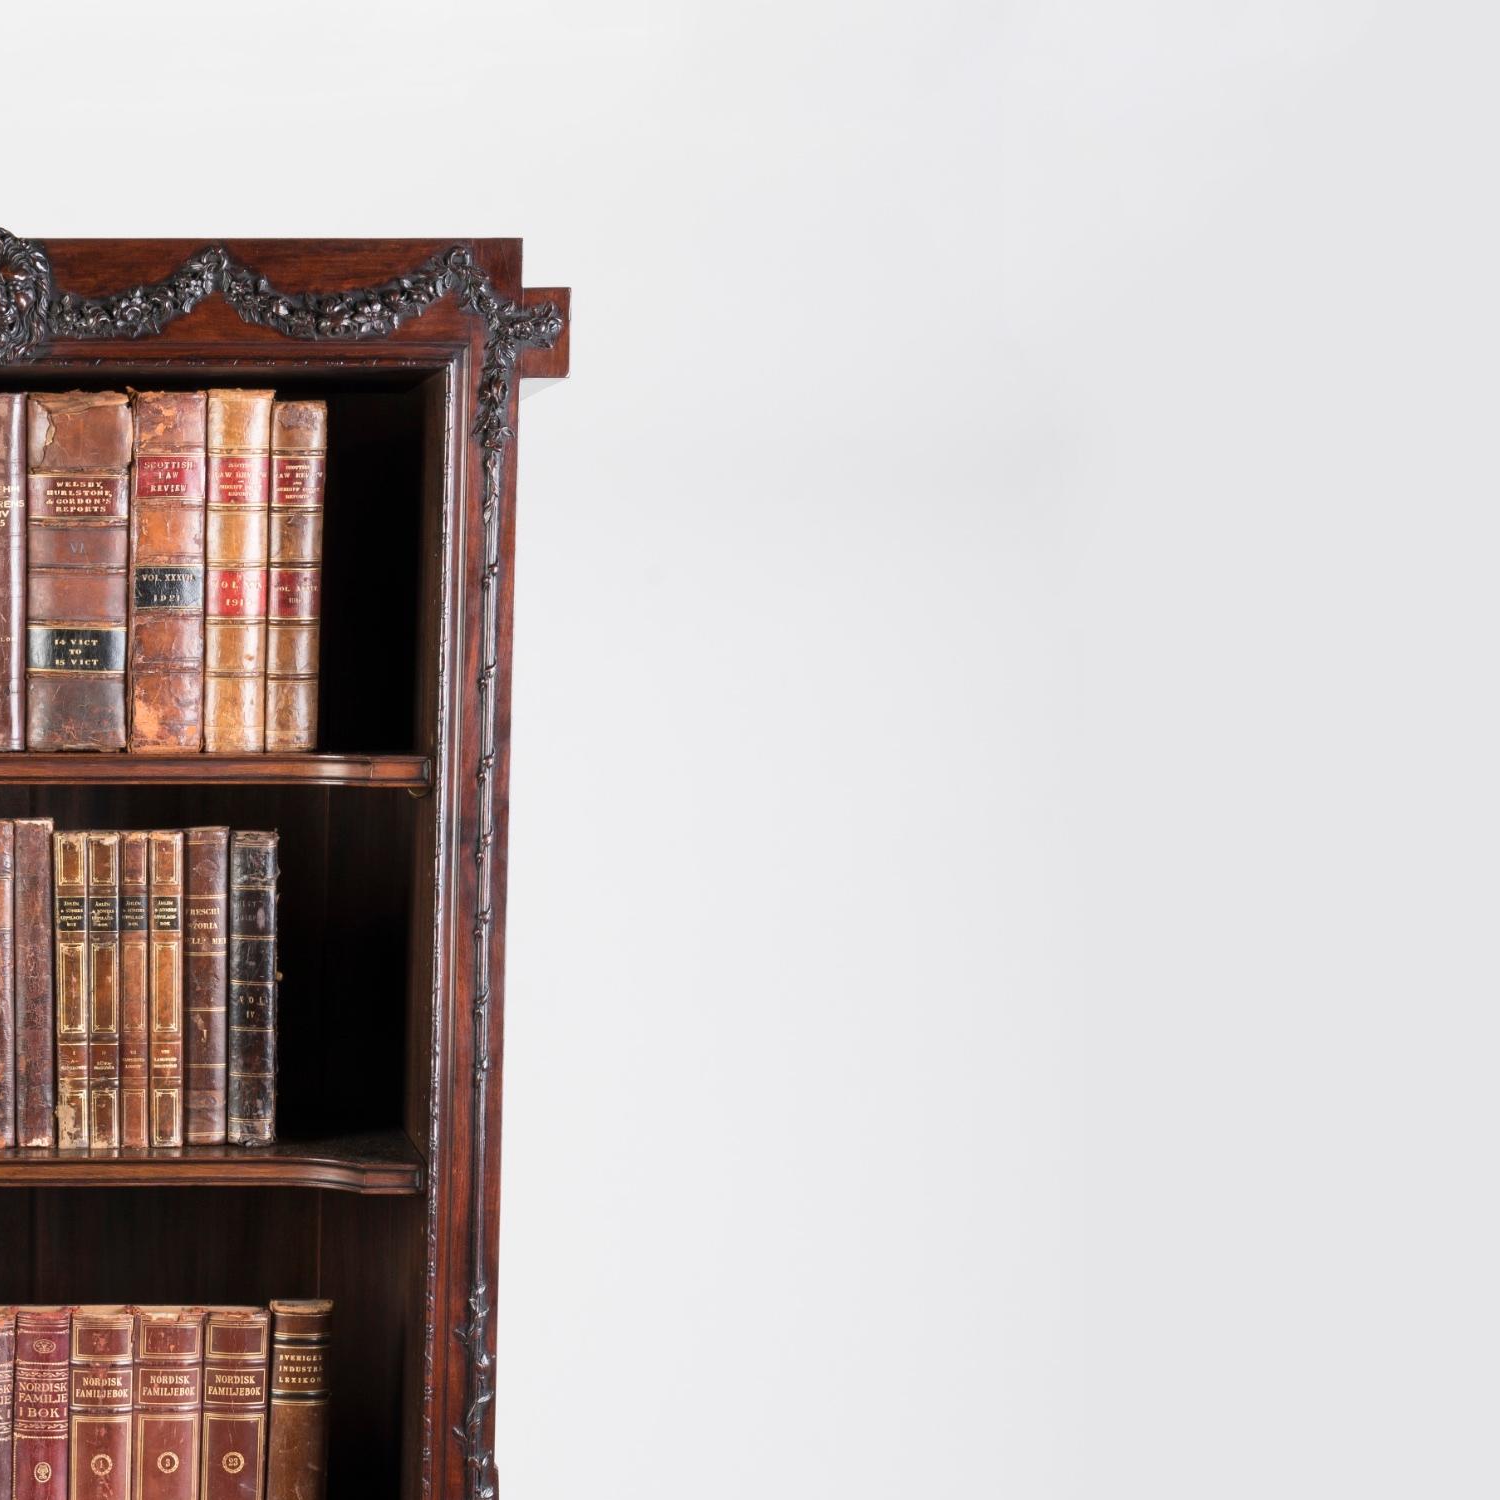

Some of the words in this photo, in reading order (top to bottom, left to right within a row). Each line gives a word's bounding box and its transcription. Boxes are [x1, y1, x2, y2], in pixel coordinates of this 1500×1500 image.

[144, 461, 193, 470] SCOTTISH
[56, 481, 103, 489] WELSBY,
[150, 484, 188, 492] REVIEW
[153, 594, 180, 602] 1921
[246, 1010, 255, 1019] IV
[82, 1377, 123, 1387] NORDISK
[150, 1375, 190, 1384] NORDISK
[215, 1374, 256, 1385] NORDISK
[278, 1376, 322, 1384] LEXIKON
[19, 1381, 68, 1392] NORDISK
[142, 1386, 196, 1396] FAMILJEBOK
[75, 1389, 129, 1398] FAMILJEBOK
[208, 1386, 261, 1397] FAMILJEBOK
[19, 1392, 68, 1403] FAMILJE
[28, 1407, 60, 1418] BOK
[227, 1457, 238, 1467] 23
